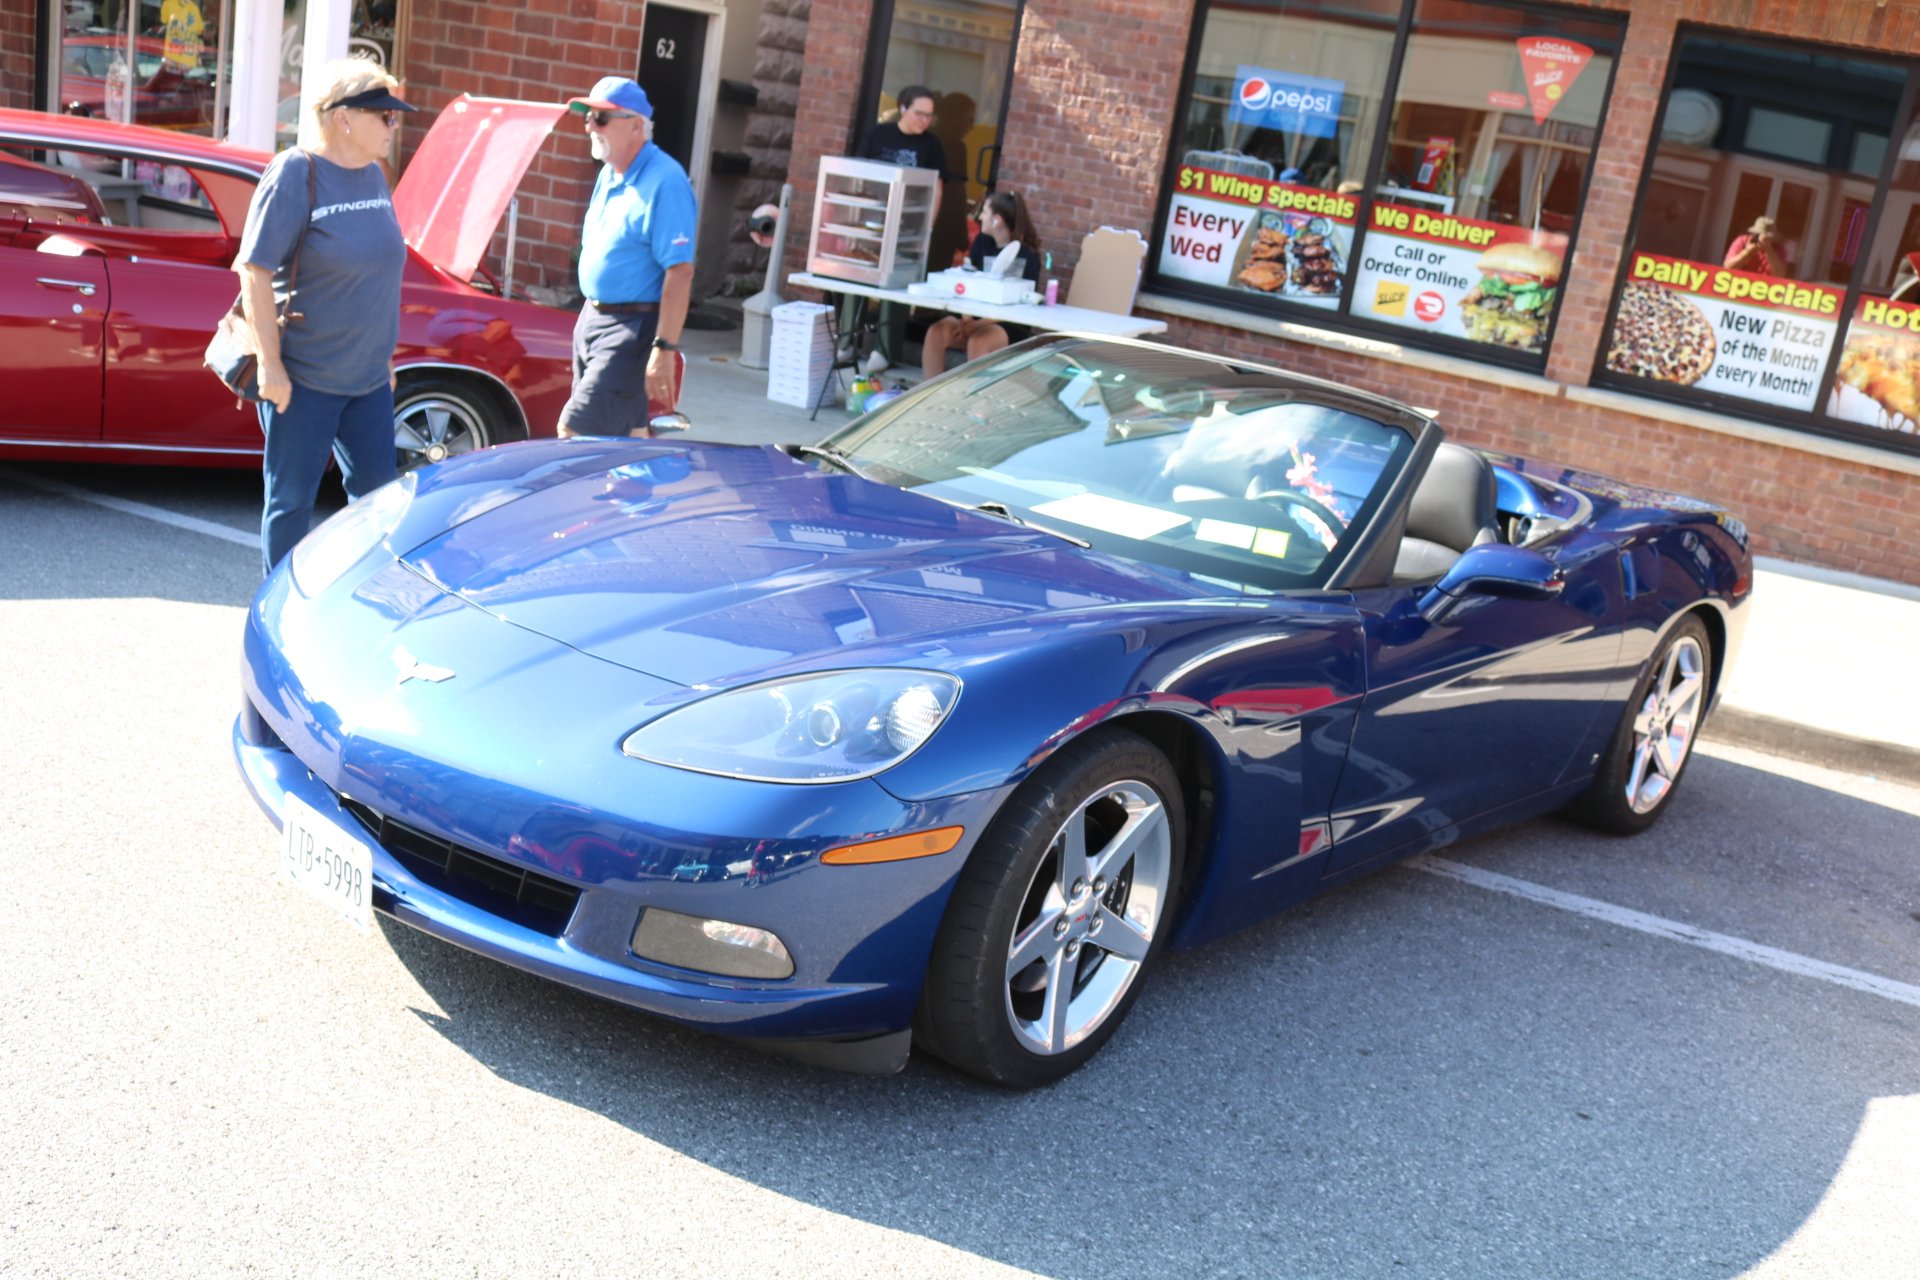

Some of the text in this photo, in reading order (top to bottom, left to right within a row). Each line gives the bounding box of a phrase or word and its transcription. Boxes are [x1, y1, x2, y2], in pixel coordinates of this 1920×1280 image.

[656, 37, 676, 59] 62
[1525, 48, 1581, 64] FAVORITE
[1535, 41, 1573, 55] LOCAL
[1270, 89, 1333, 113] pepsi
[1179, 167, 1355, 219] $1 Wing Specials
[1174, 205, 1245, 239] Every
[1374, 205, 1495, 246] We Deliver
[1170, 235, 1222, 263] Wed
[1394, 245, 1447, 265] Call or
[1365, 257, 1468, 289] Order Online
[1633, 255, 1837, 314] Daily Specials
[1720, 309, 1826, 348] New Pizza
[1722, 338, 1819, 373] of the Month
[1716, 363, 1813, 397] every Month!
[323, 846, 362, 907] 5998
